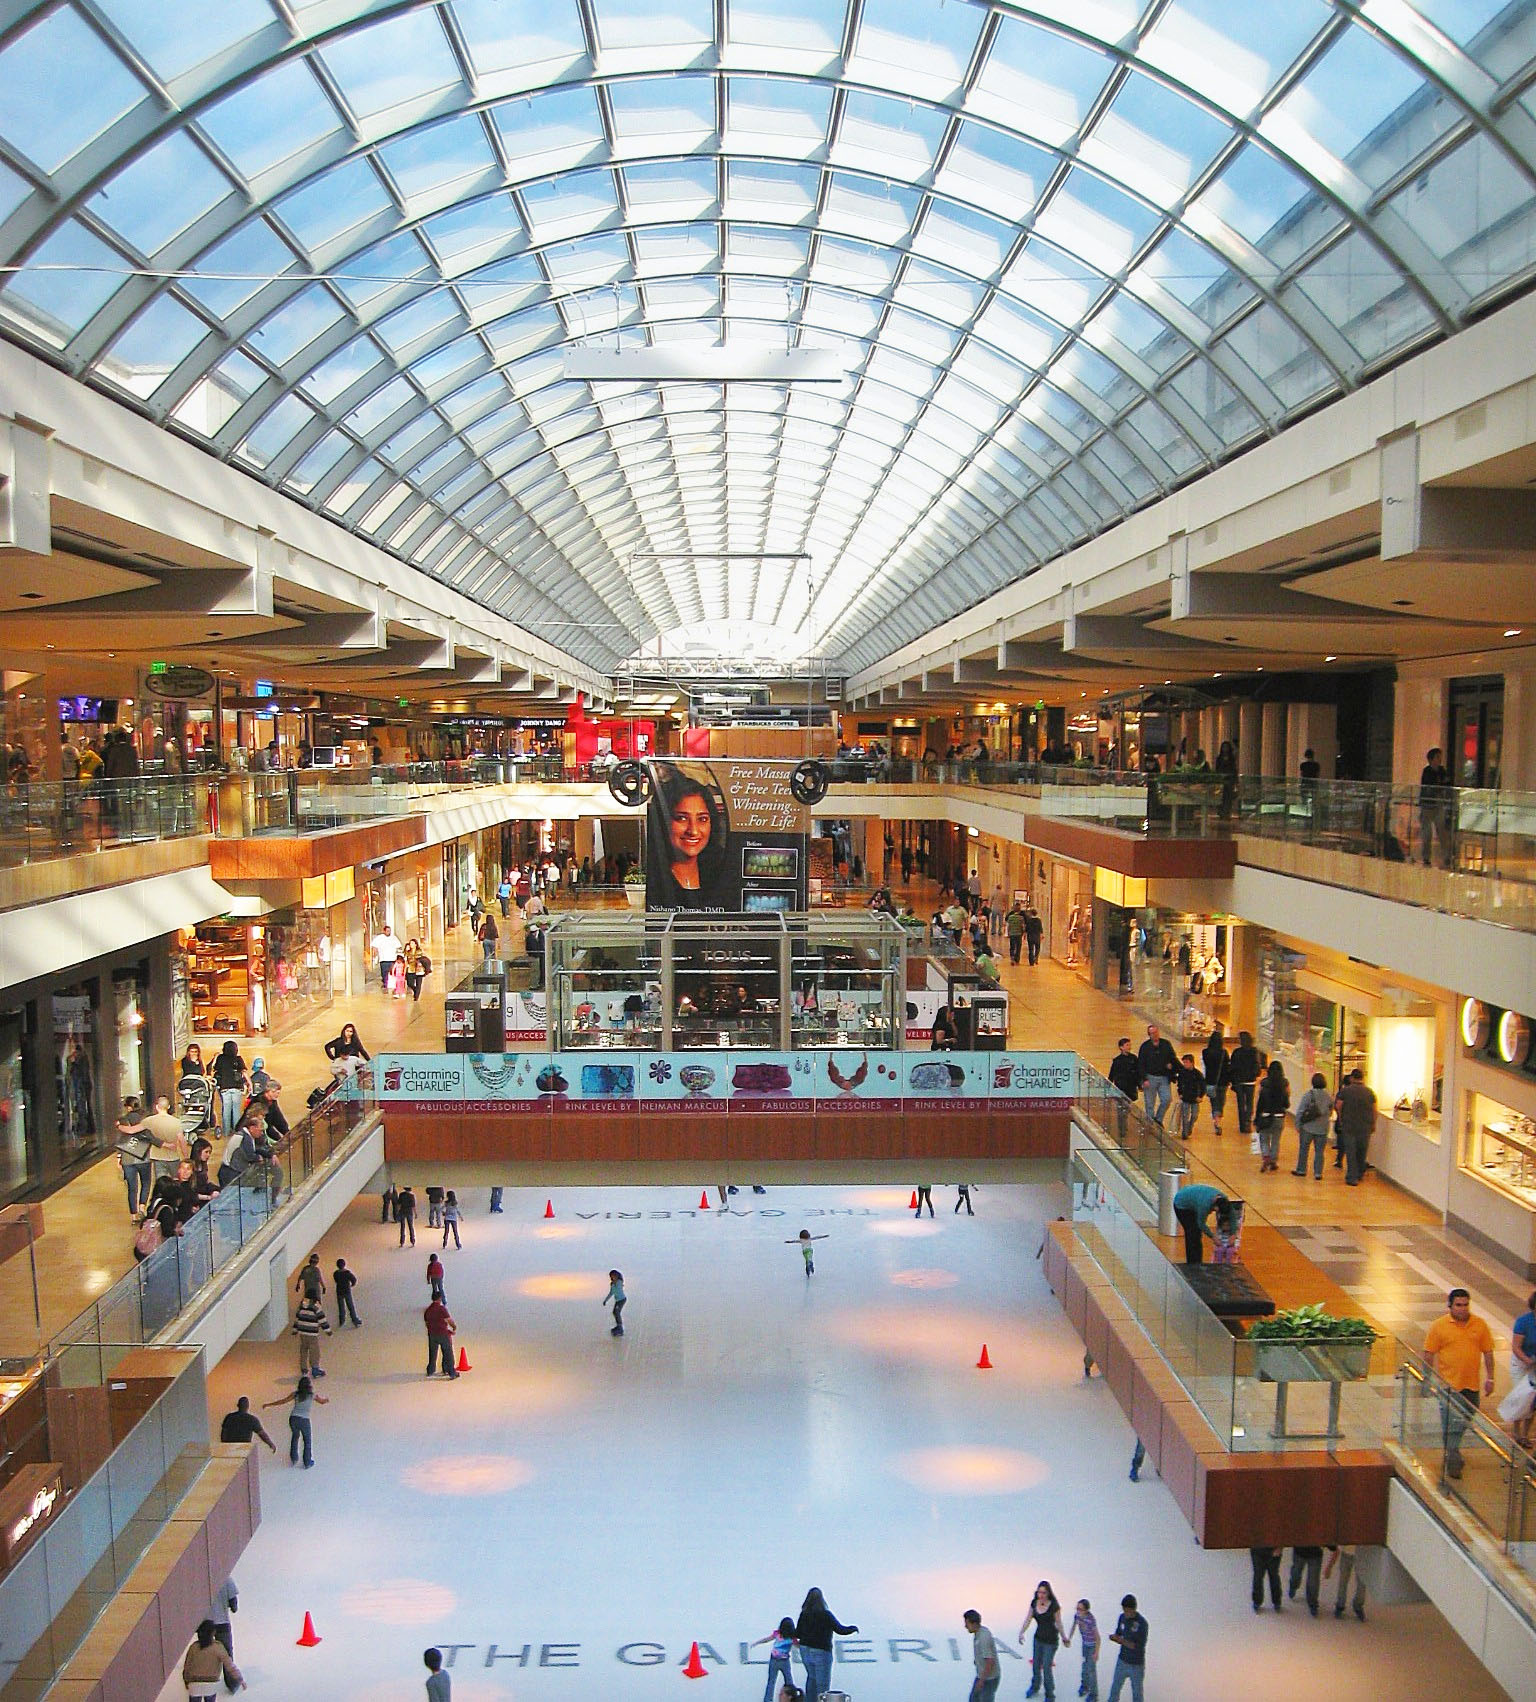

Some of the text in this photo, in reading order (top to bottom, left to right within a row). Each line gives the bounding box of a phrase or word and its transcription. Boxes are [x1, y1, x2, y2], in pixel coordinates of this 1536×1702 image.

[729, 766, 791, 780] Free Massa
[730, 781, 742, 794] &
[745, 783, 768, 795] Free
[733, 798, 800, 814] Whitening...
[736, 814, 797, 830] ...For Life!
[701, 950, 752, 963] TOUS
[979, 1012, 997, 1022] RLIE
[403, 1066, 460, 1085] charming
[1013, 1064, 1071, 1082] charming
[405, 1081, 452, 1092] CHARLIE
[1015, 1077, 1062, 1089] CHARLIE
[415, 1103, 464, 1111] FABULOUS
[466, 1103, 531, 1111] ACCESSORIES
[565, 1103, 589, 1111] RINK
[620, 1102, 632, 1110] BY
[641, 1102, 681, 1110] NEIMAN
[685, 1102, 725, 1110] MARCUS
[762, 1102, 810, 1110] FABULOUS
[817, 1101, 882, 1110] ACCESSORIES
[915, 1101, 937, 1109] RINK
[940, 1101, 967, 1109] LEVEL
[969, 1101, 981, 1109] BY
[989, 1101, 1027, 1109] NEIMAN
[1030, 1100, 1069, 1108] MARCUS
[435, 1637, 1023, 1668] THE GALERIA
